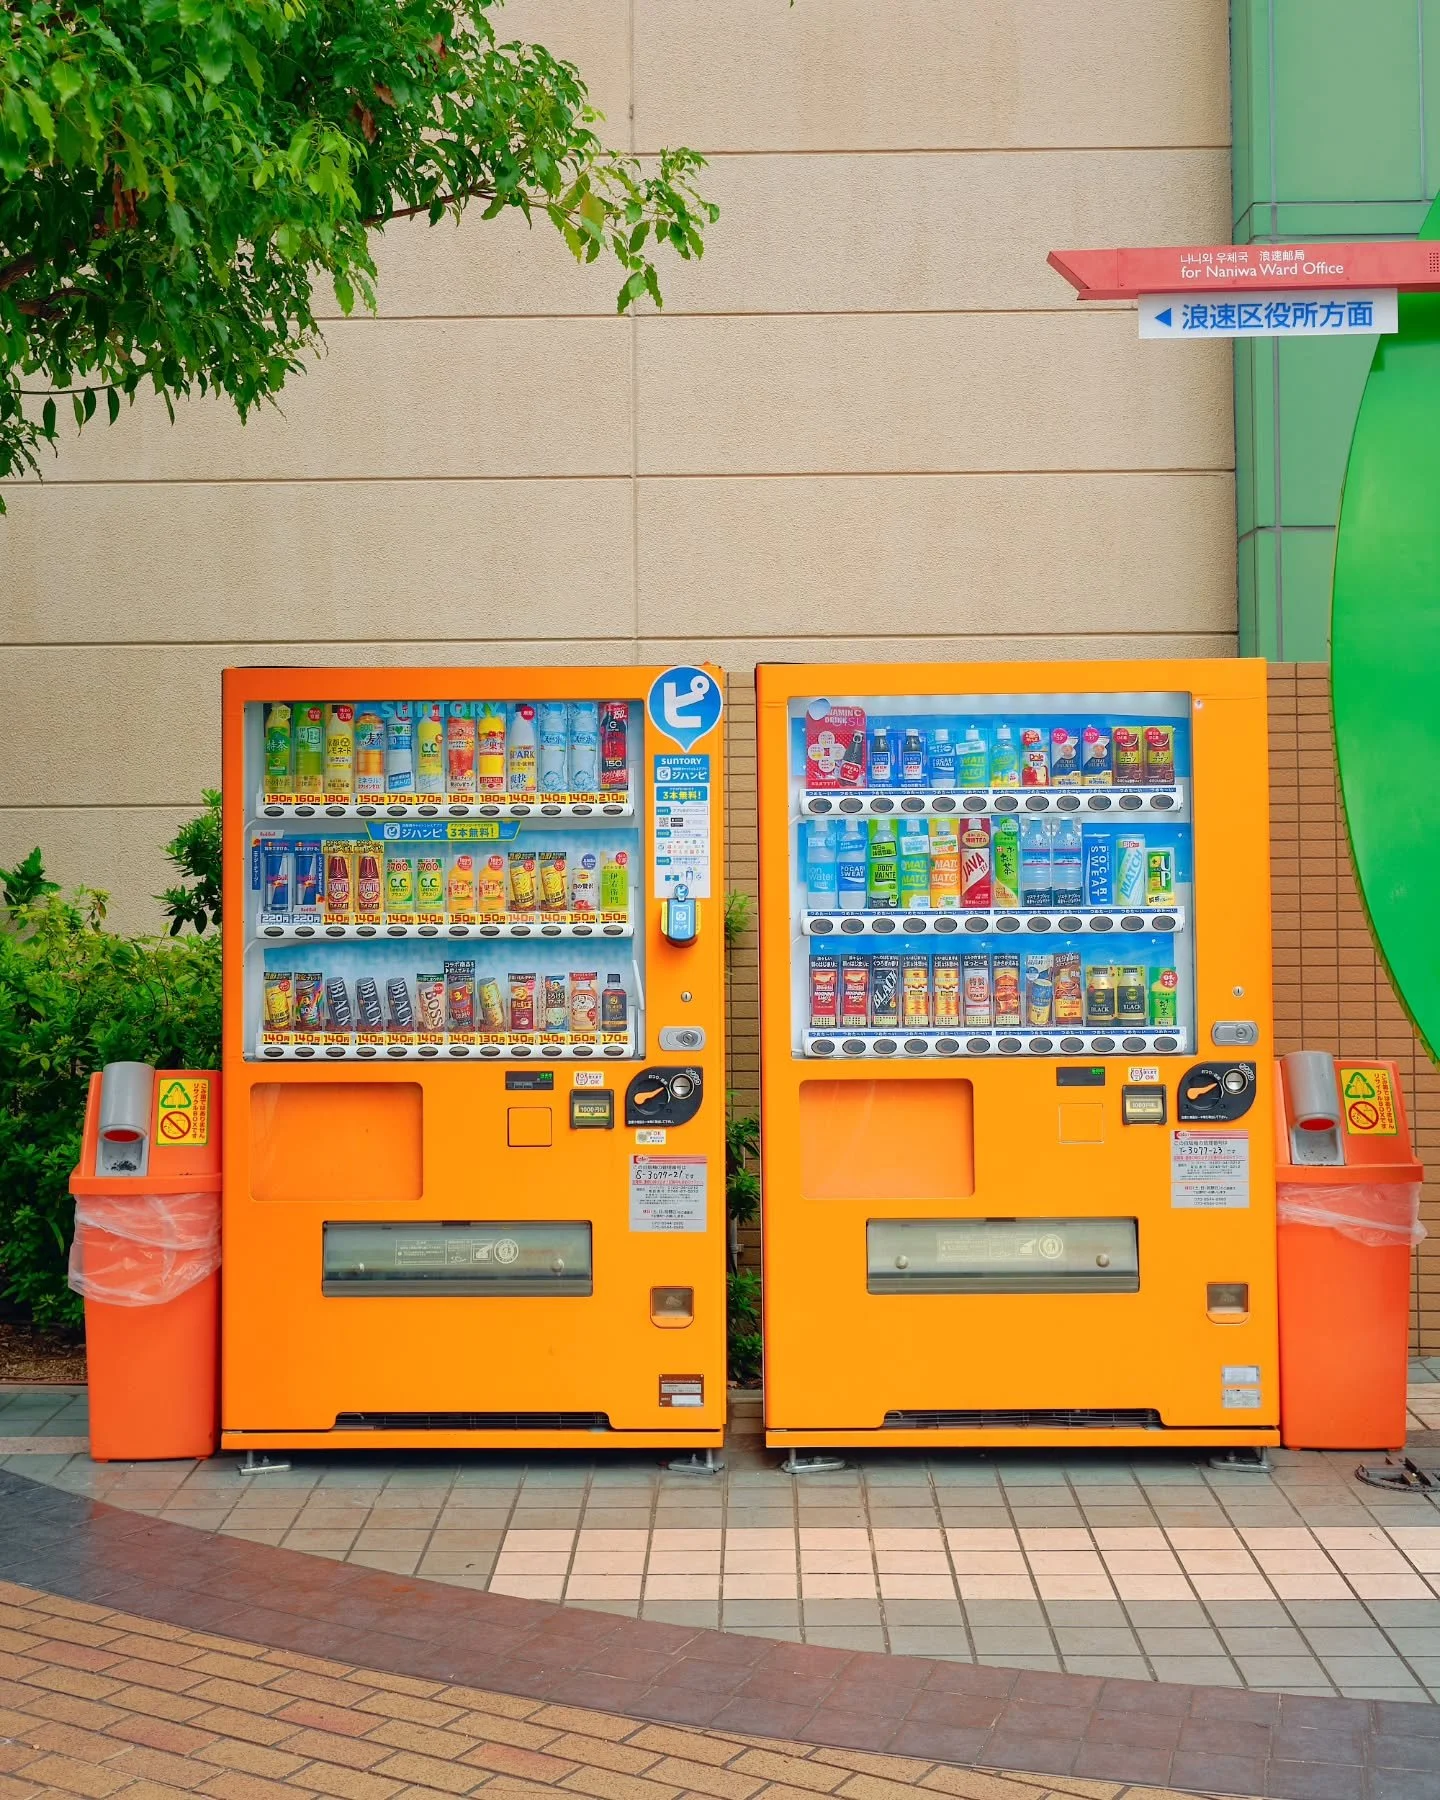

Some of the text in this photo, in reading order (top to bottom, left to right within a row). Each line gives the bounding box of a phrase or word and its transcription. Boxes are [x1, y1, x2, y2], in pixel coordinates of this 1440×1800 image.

[1181, 251, 1248, 264] 나니와 우체국
[1181, 262, 1344, 278] for Naniwa Ward Office
[1182, 301, 1374, 330] 浪速区役所方面
[672, 771, 707, 780] ジハンピ
[402, 829, 442, 838] ジハンピ
[450, 828, 494, 838] 3本無料!
[963, 852, 985, 882] JAVA
[1091, 846, 1099, 897] SWEAT
[1099, 846, 1108, 902] POCARI
[1120, 849, 1143, 898] MATCH
[324, 914, 349, 922] 140円
[355, 914, 380, 922] 140円
[388, 914, 413, 922] 140円
[417, 914, 443, 922] 140円
[450, 914, 475, 922] 150円
[480, 914, 505, 922] 150円
[509, 914, 534, 922] 140円
[873, 969, 898, 1009] BLACK
[330, 979, 352, 1026] BLACK
[360, 979, 383, 1026] BLACK
[391, 979, 413, 1027] BLACK
[199, 1083, 207, 1139] ごみ箱ではありません
[1374, 1073, 1387, 1129] リサイクルBOXです
[1381, 1073, 1395, 1129] ごみ箱ではありません
